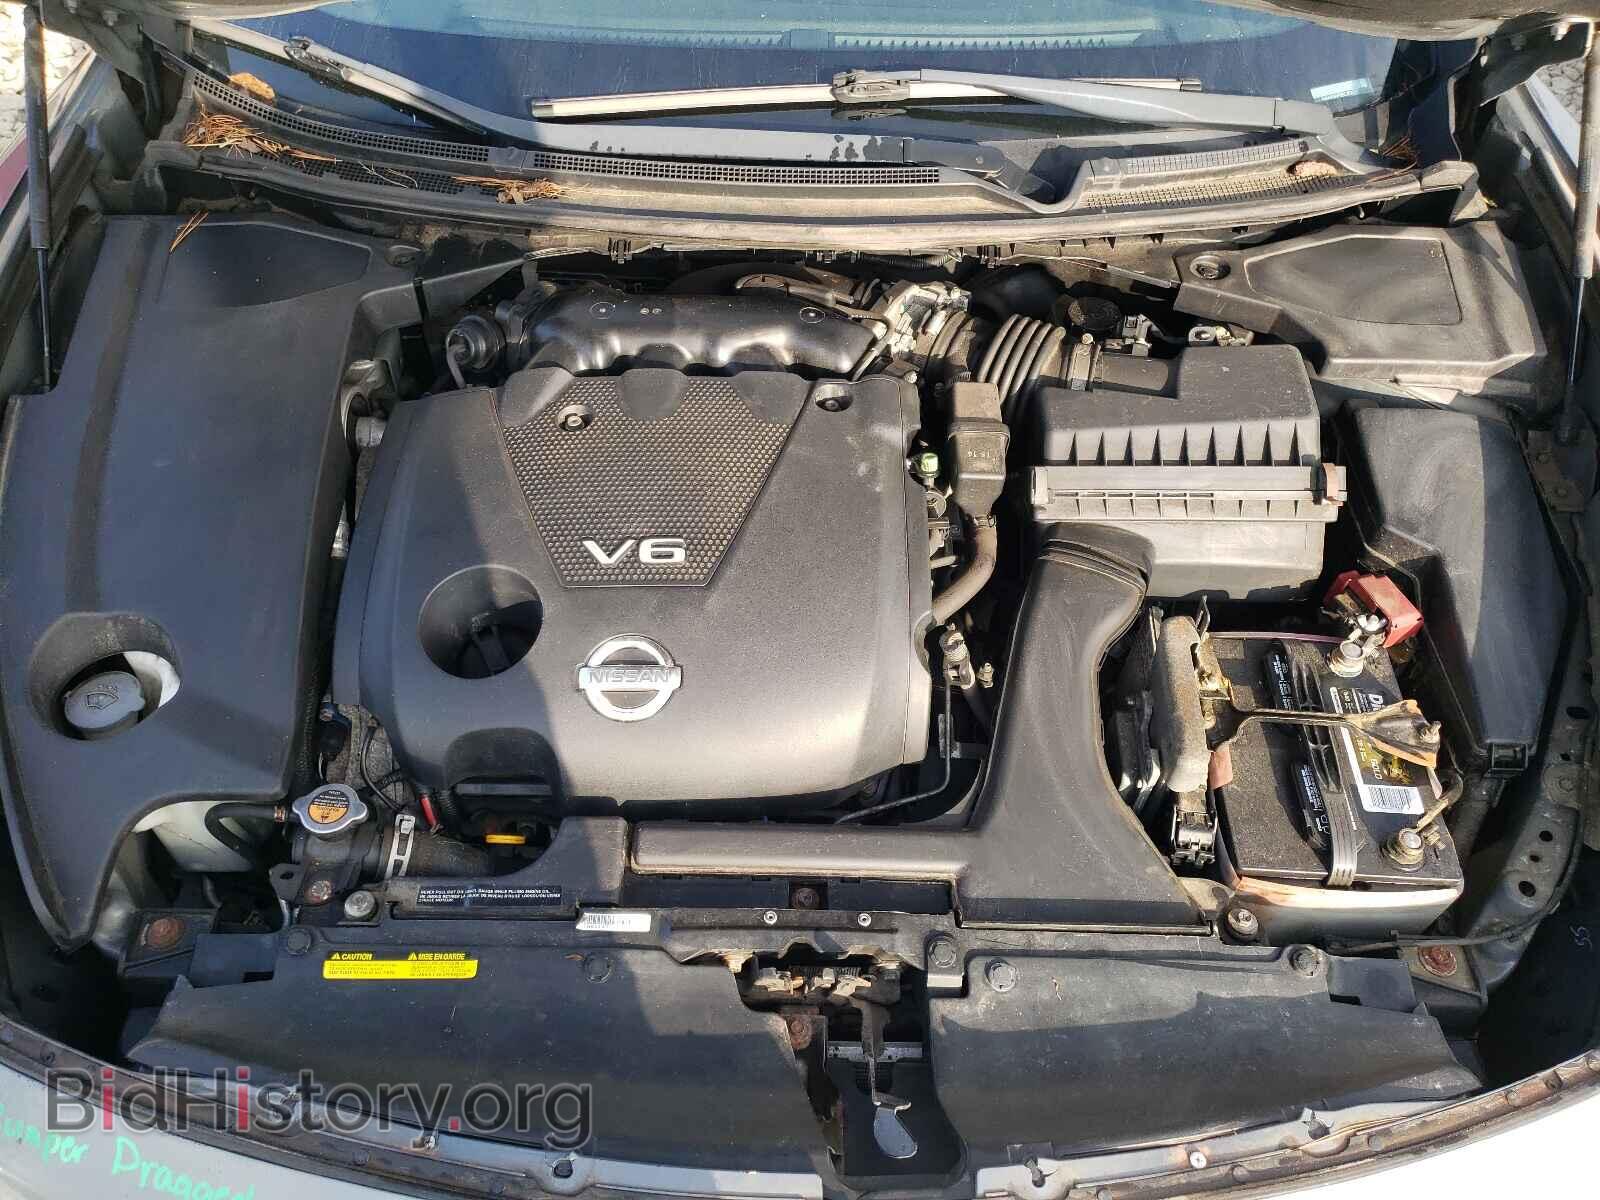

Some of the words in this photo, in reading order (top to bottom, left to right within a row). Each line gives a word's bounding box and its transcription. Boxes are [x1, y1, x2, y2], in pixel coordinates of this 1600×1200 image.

[582, 538, 687, 565] V6
[588, 668, 671, 684] NISSAN
[341, 952, 373, 960] CAUTION
[417, 952, 434, 960] MISE
[442, 952, 466, 960] GARDE
[0, 1103, 90, 1168] umper
